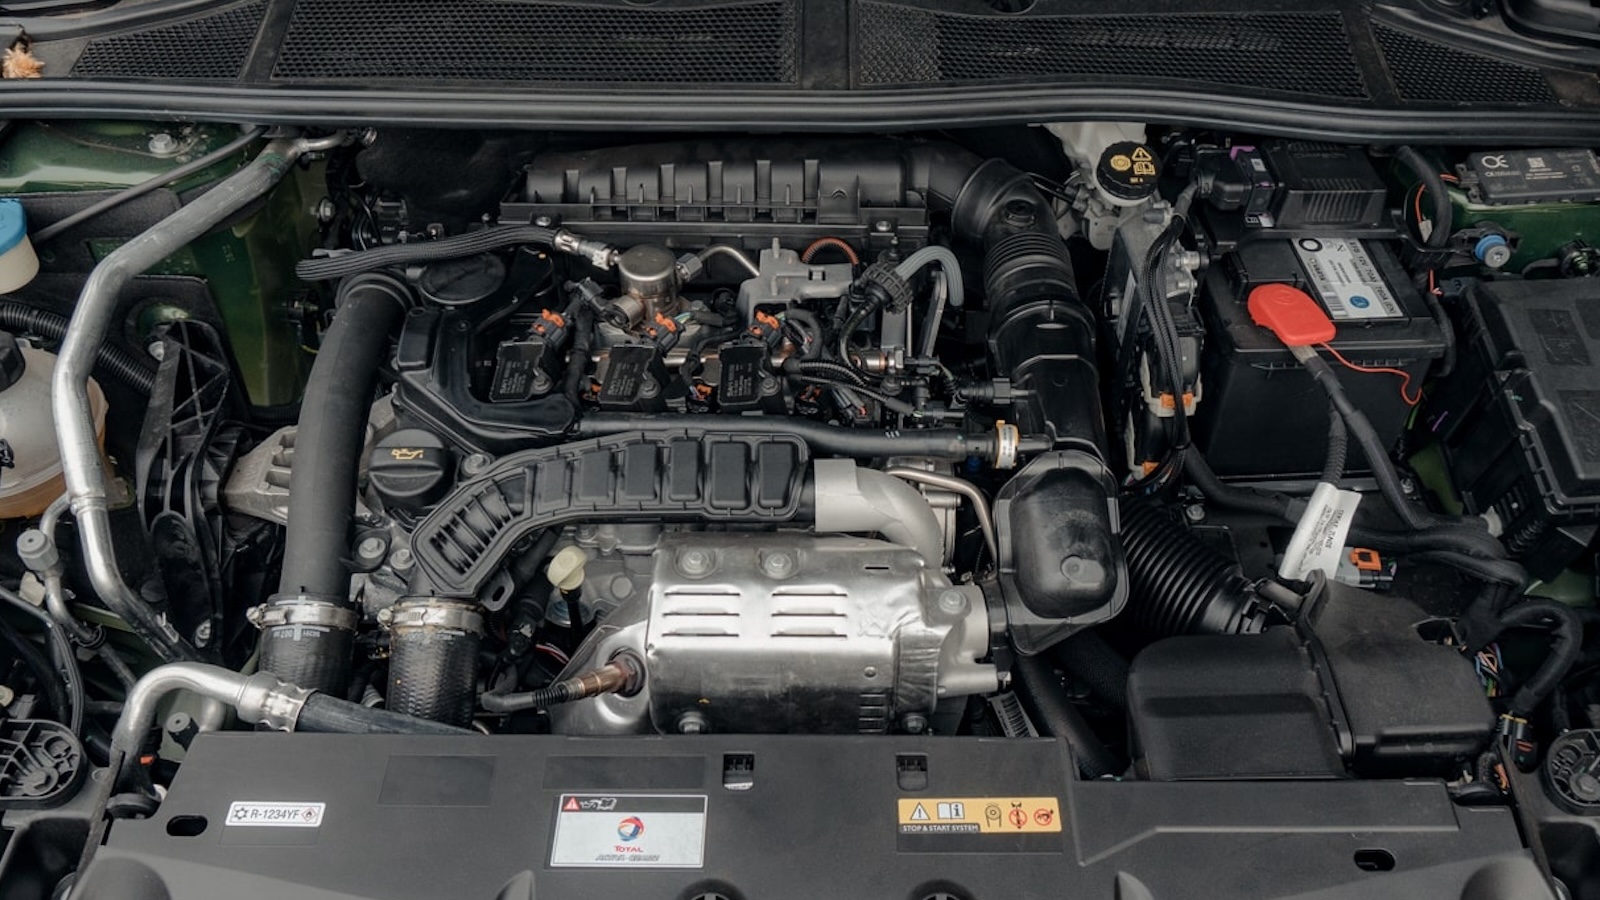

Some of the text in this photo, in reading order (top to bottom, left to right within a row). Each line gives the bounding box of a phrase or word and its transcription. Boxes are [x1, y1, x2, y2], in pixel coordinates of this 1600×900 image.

[250, 809, 300, 819] R-1234YF
[903, 824, 978, 832] STOP & START SYSTEM
